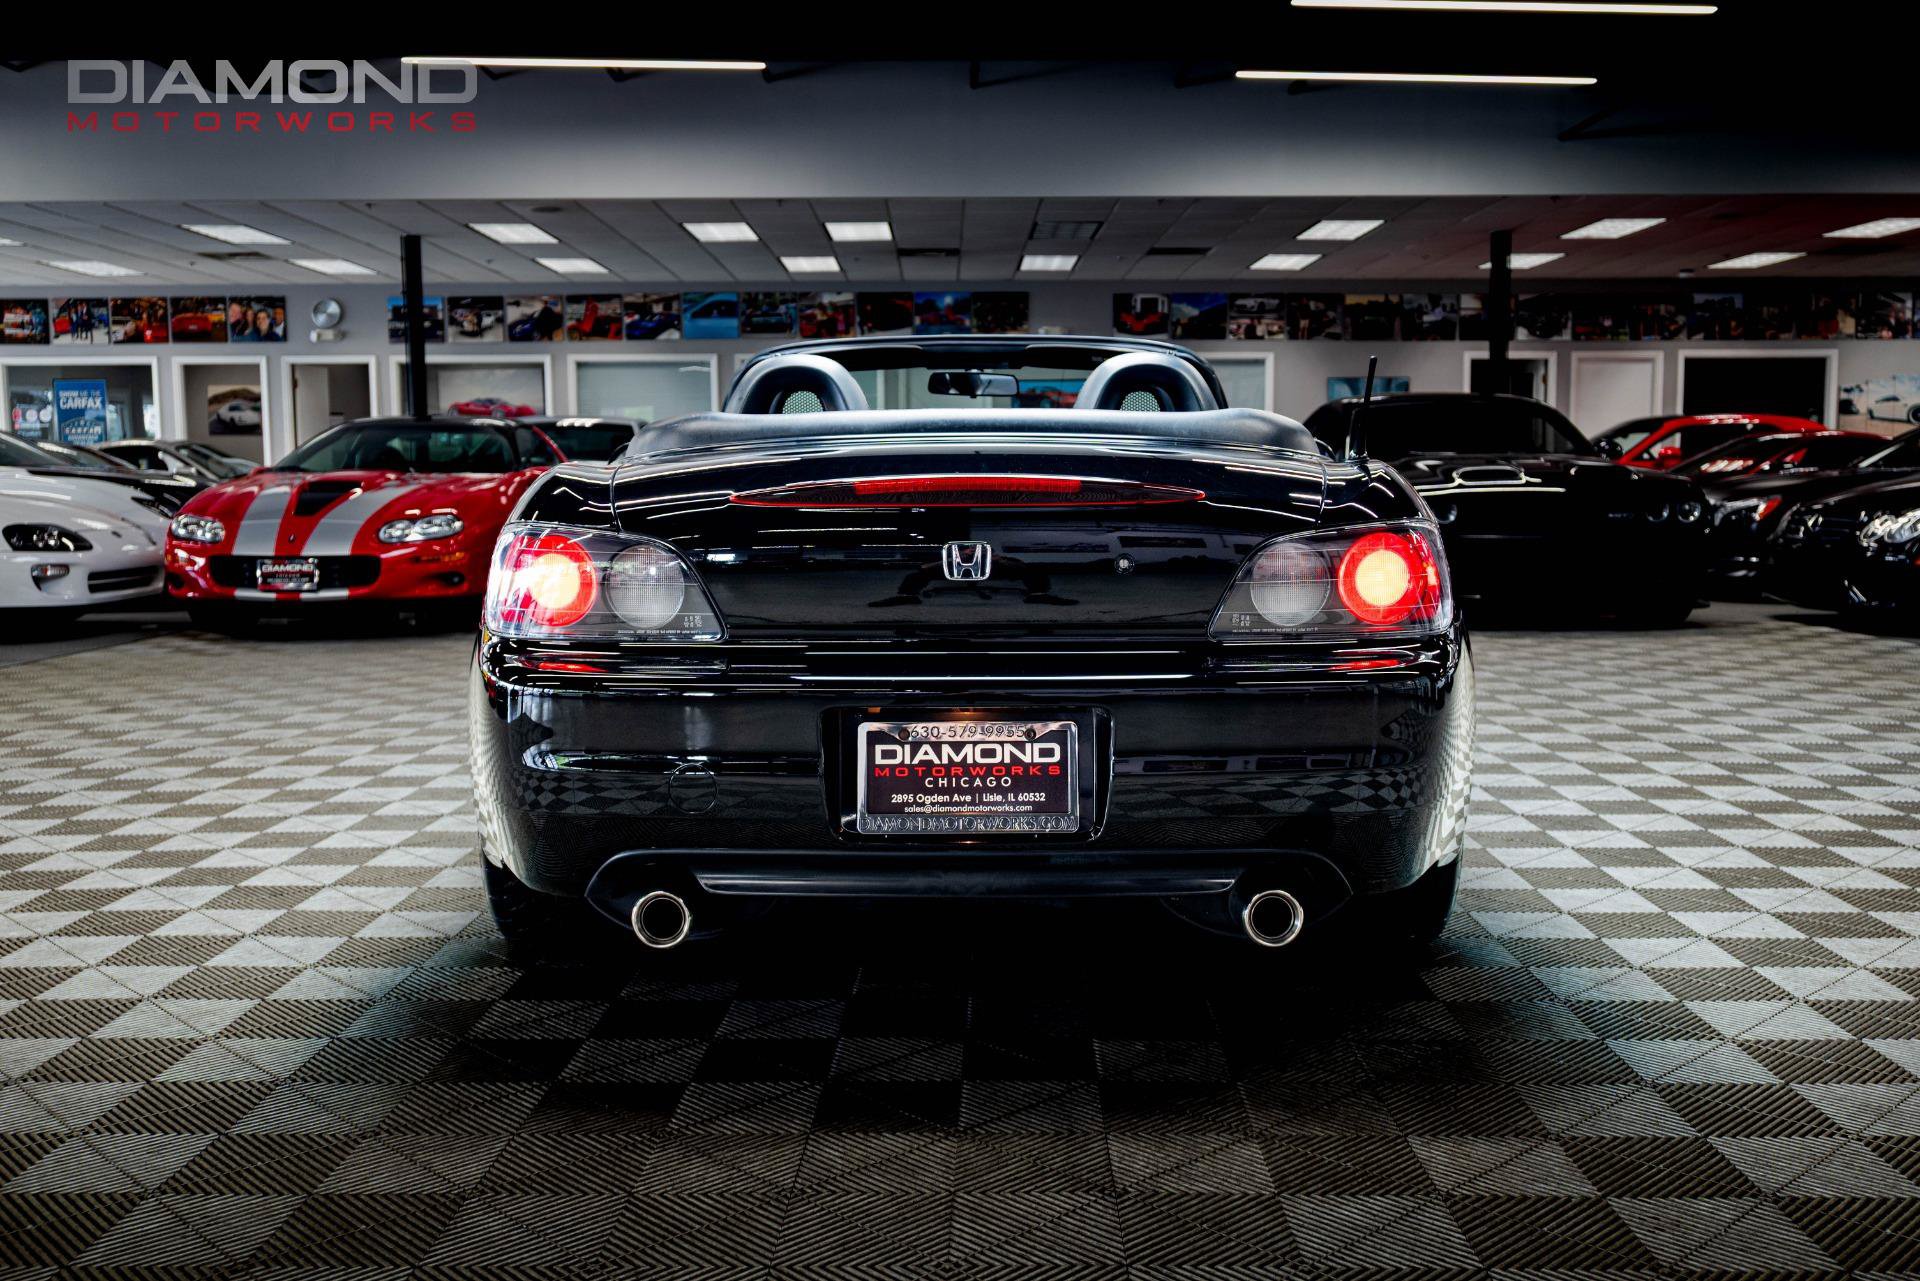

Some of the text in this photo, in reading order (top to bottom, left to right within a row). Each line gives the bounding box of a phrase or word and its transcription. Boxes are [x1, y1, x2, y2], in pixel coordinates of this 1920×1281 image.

[60, 397, 102, 410] CARFAX
[261, 564, 314, 572] DIAMOND
[910, 725, 1025, 739] 630-579-9955
[875, 743, 1061, 765] DIAMOND
[874, 765, 1061, 777] MOTORWORKS
[924, 776, 1012, 788] CHICAGO
[891, 794, 914, 803] 2895
[916, 793, 950, 804] Ogden
[952, 793, 972, 802] Ave
[1007, 792, 1016, 801] IL
[1017, 792, 1046, 802] 60532
[904, 803, 1033, 813] sales@diamondmotorworks.com
[861, 815, 1077, 832] DIAMONDMOTORWORKS.COM
